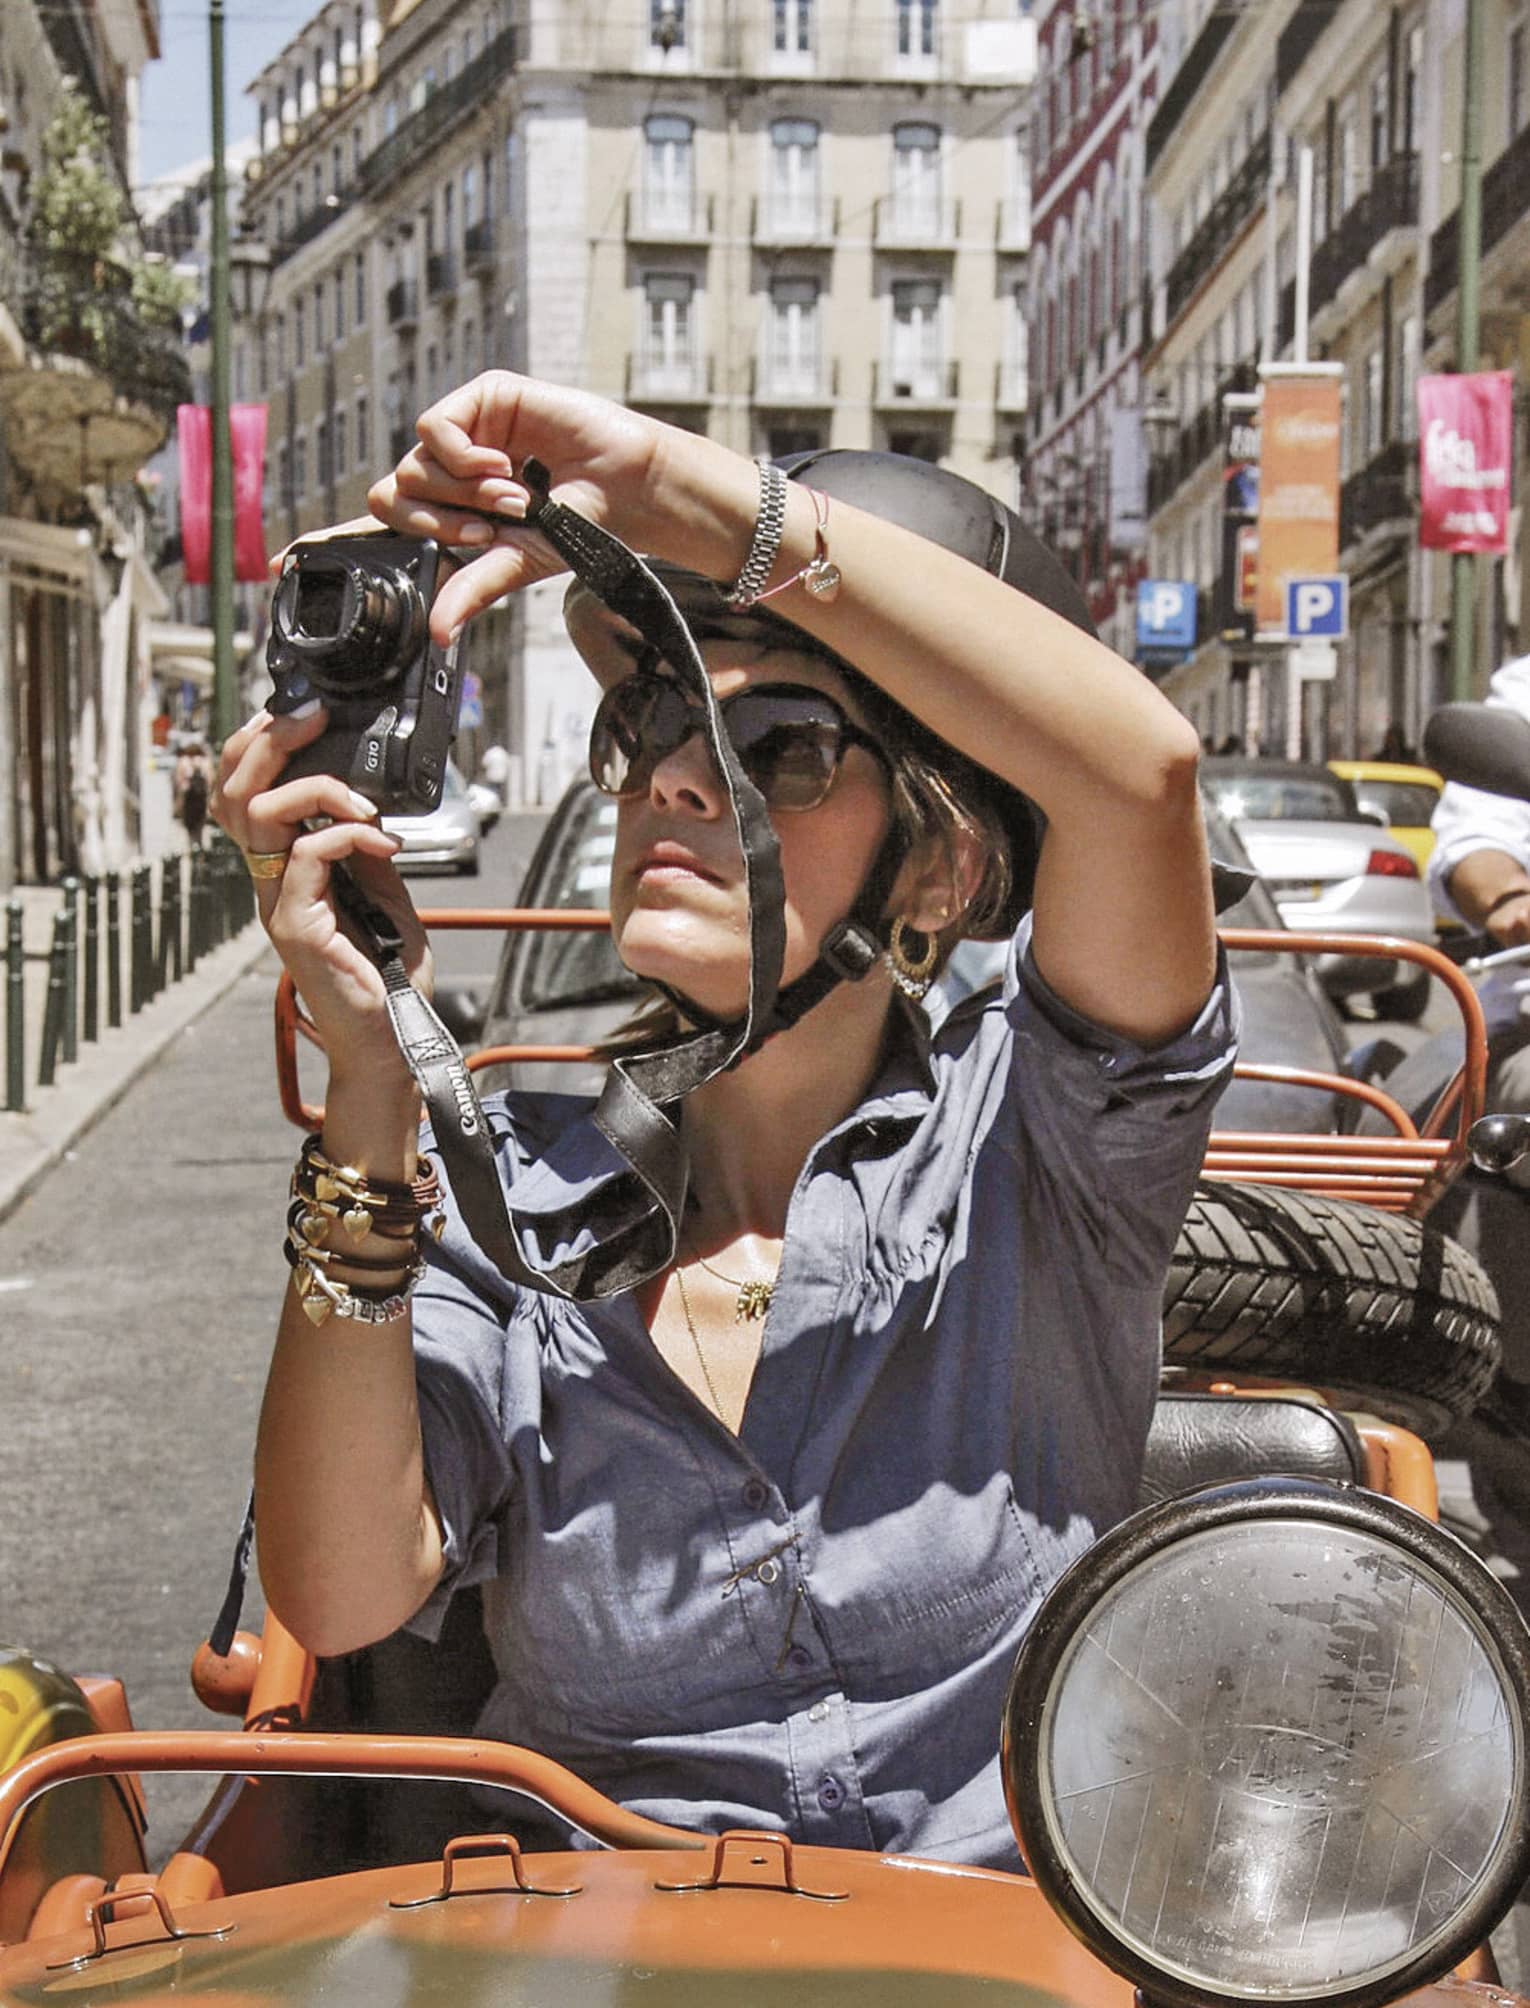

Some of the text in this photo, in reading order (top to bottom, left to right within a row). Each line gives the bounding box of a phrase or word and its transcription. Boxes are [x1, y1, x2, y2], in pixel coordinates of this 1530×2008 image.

[1153, 584, 1183, 630] P
[1296, 584, 1334, 632] P
[367, 740, 380, 769] G10
[446, 1065, 479, 1137] Canon
